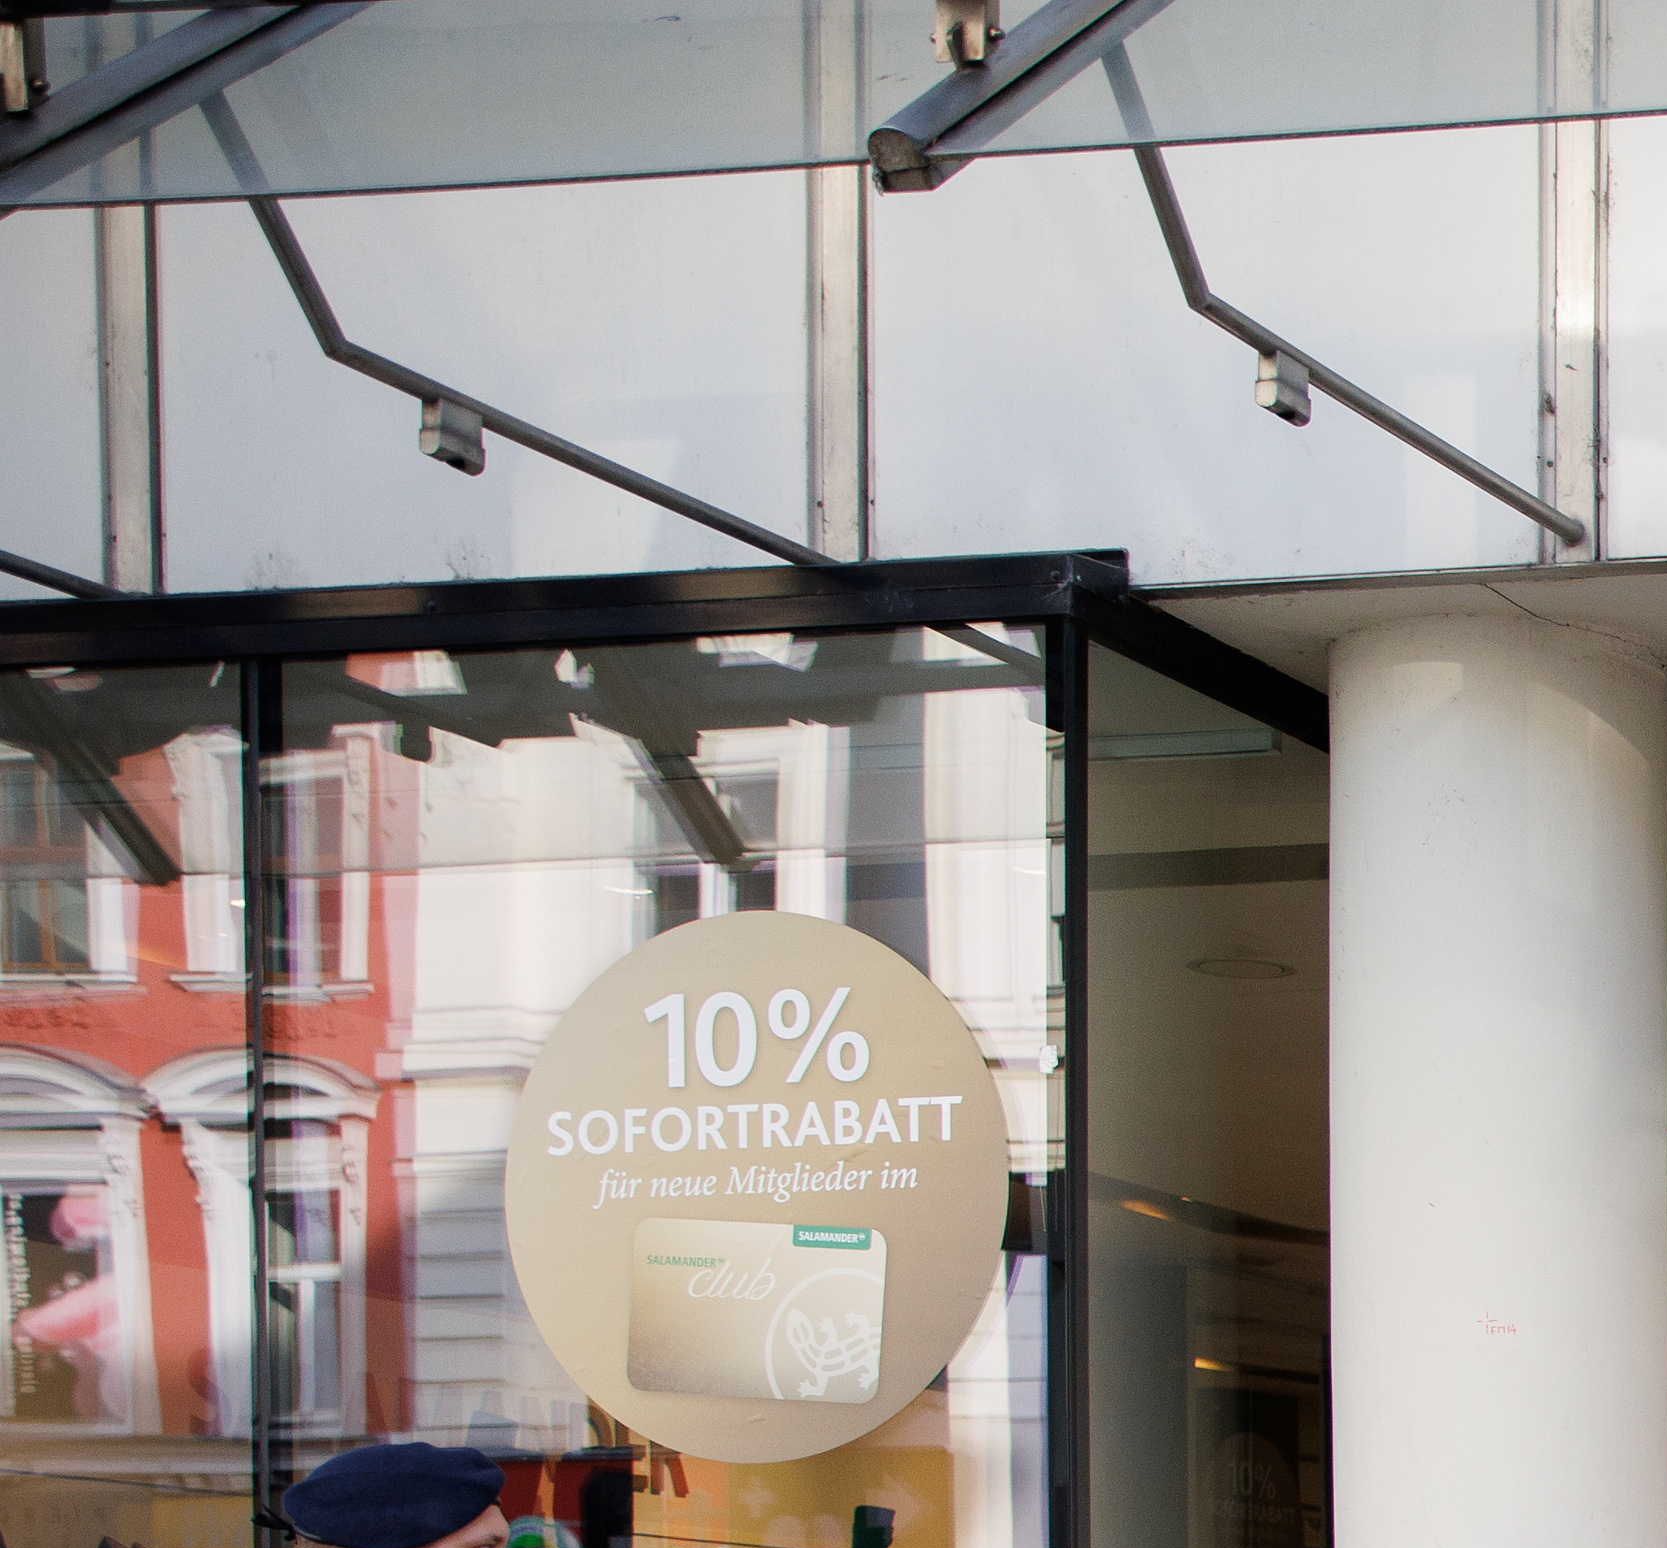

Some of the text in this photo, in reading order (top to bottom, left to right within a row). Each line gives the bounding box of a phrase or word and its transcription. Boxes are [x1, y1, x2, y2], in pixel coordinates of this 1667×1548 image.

[643, 986, 870, 1089] 10%
[546, 1095, 963, 1157] SOFORTRABATT
[592, 1160, 918, 1209] für neue Mitglieder im
[797, 1230, 859, 1244] SALAMANDER
[646, 1254, 717, 1268] SALAMANDER
[687, 1258, 779, 1301] club
